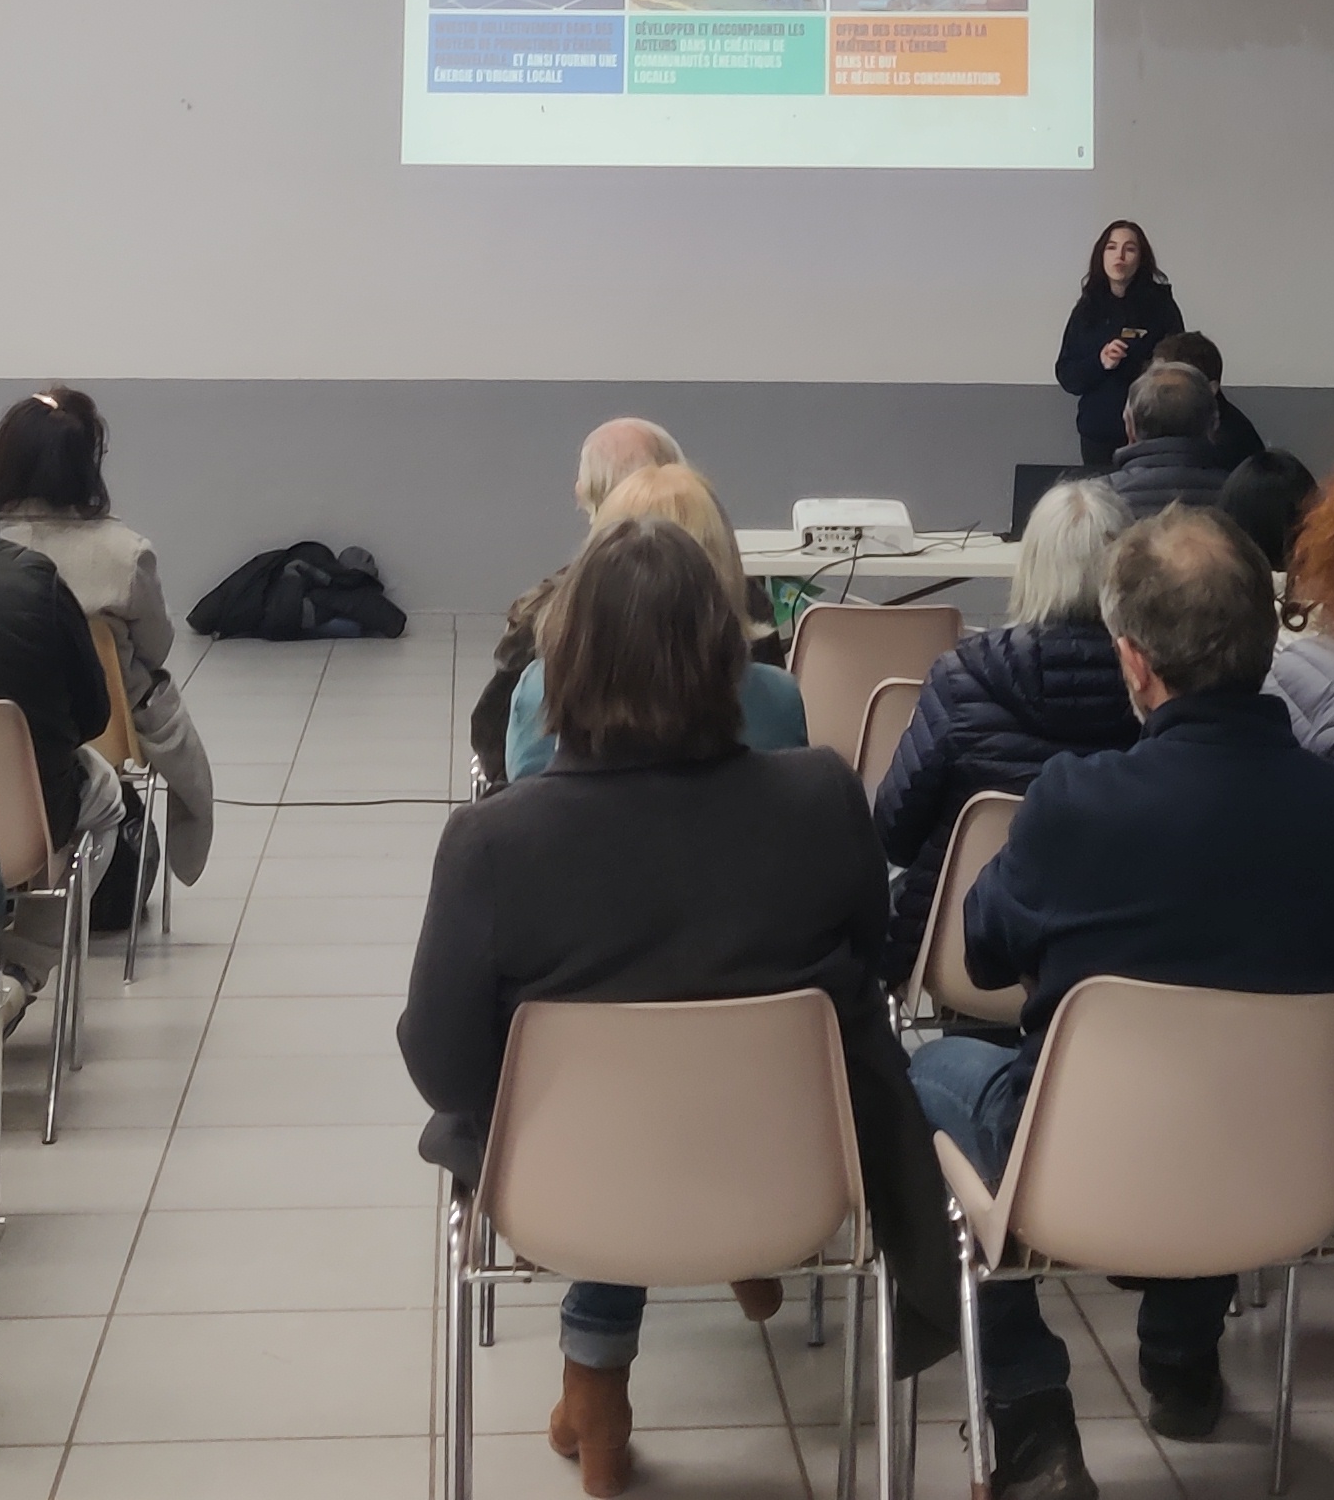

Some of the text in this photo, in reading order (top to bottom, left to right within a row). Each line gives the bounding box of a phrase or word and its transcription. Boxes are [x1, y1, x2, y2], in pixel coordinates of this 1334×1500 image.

[635, 21, 805, 37] DÉVELOPPER ET ACCOMPAGNER LES
[836, 23, 869, 37] OFFRIR
[872, 24, 890, 37] DES
[893, 24, 939, 37] SERVICES
[975, 24, 987, 37] LA
[635, 37, 785, 52] ACTEURS DANS LA CRÉATION DE
[512, 53, 525, 67] ET
[527, 53, 553, 67] AINSI
[555, 53, 597, 67] FOURNIR
[599, 54, 618, 67] UNE
[634, 52, 782, 68] COMMUNAUTÉS ÉNERGÉTIQUES
[835, 55, 897, 68] DANS LE BUT
[434, 66, 563, 83] ÉNERGIE D'ORIGINE LOCALE
[634, 70, 676, 84] LOCALES
[835, 72, 848, 85] DE
[894, 72, 911, 85] LES
[914, 72, 1002, 86] CONSOMMATIONS
